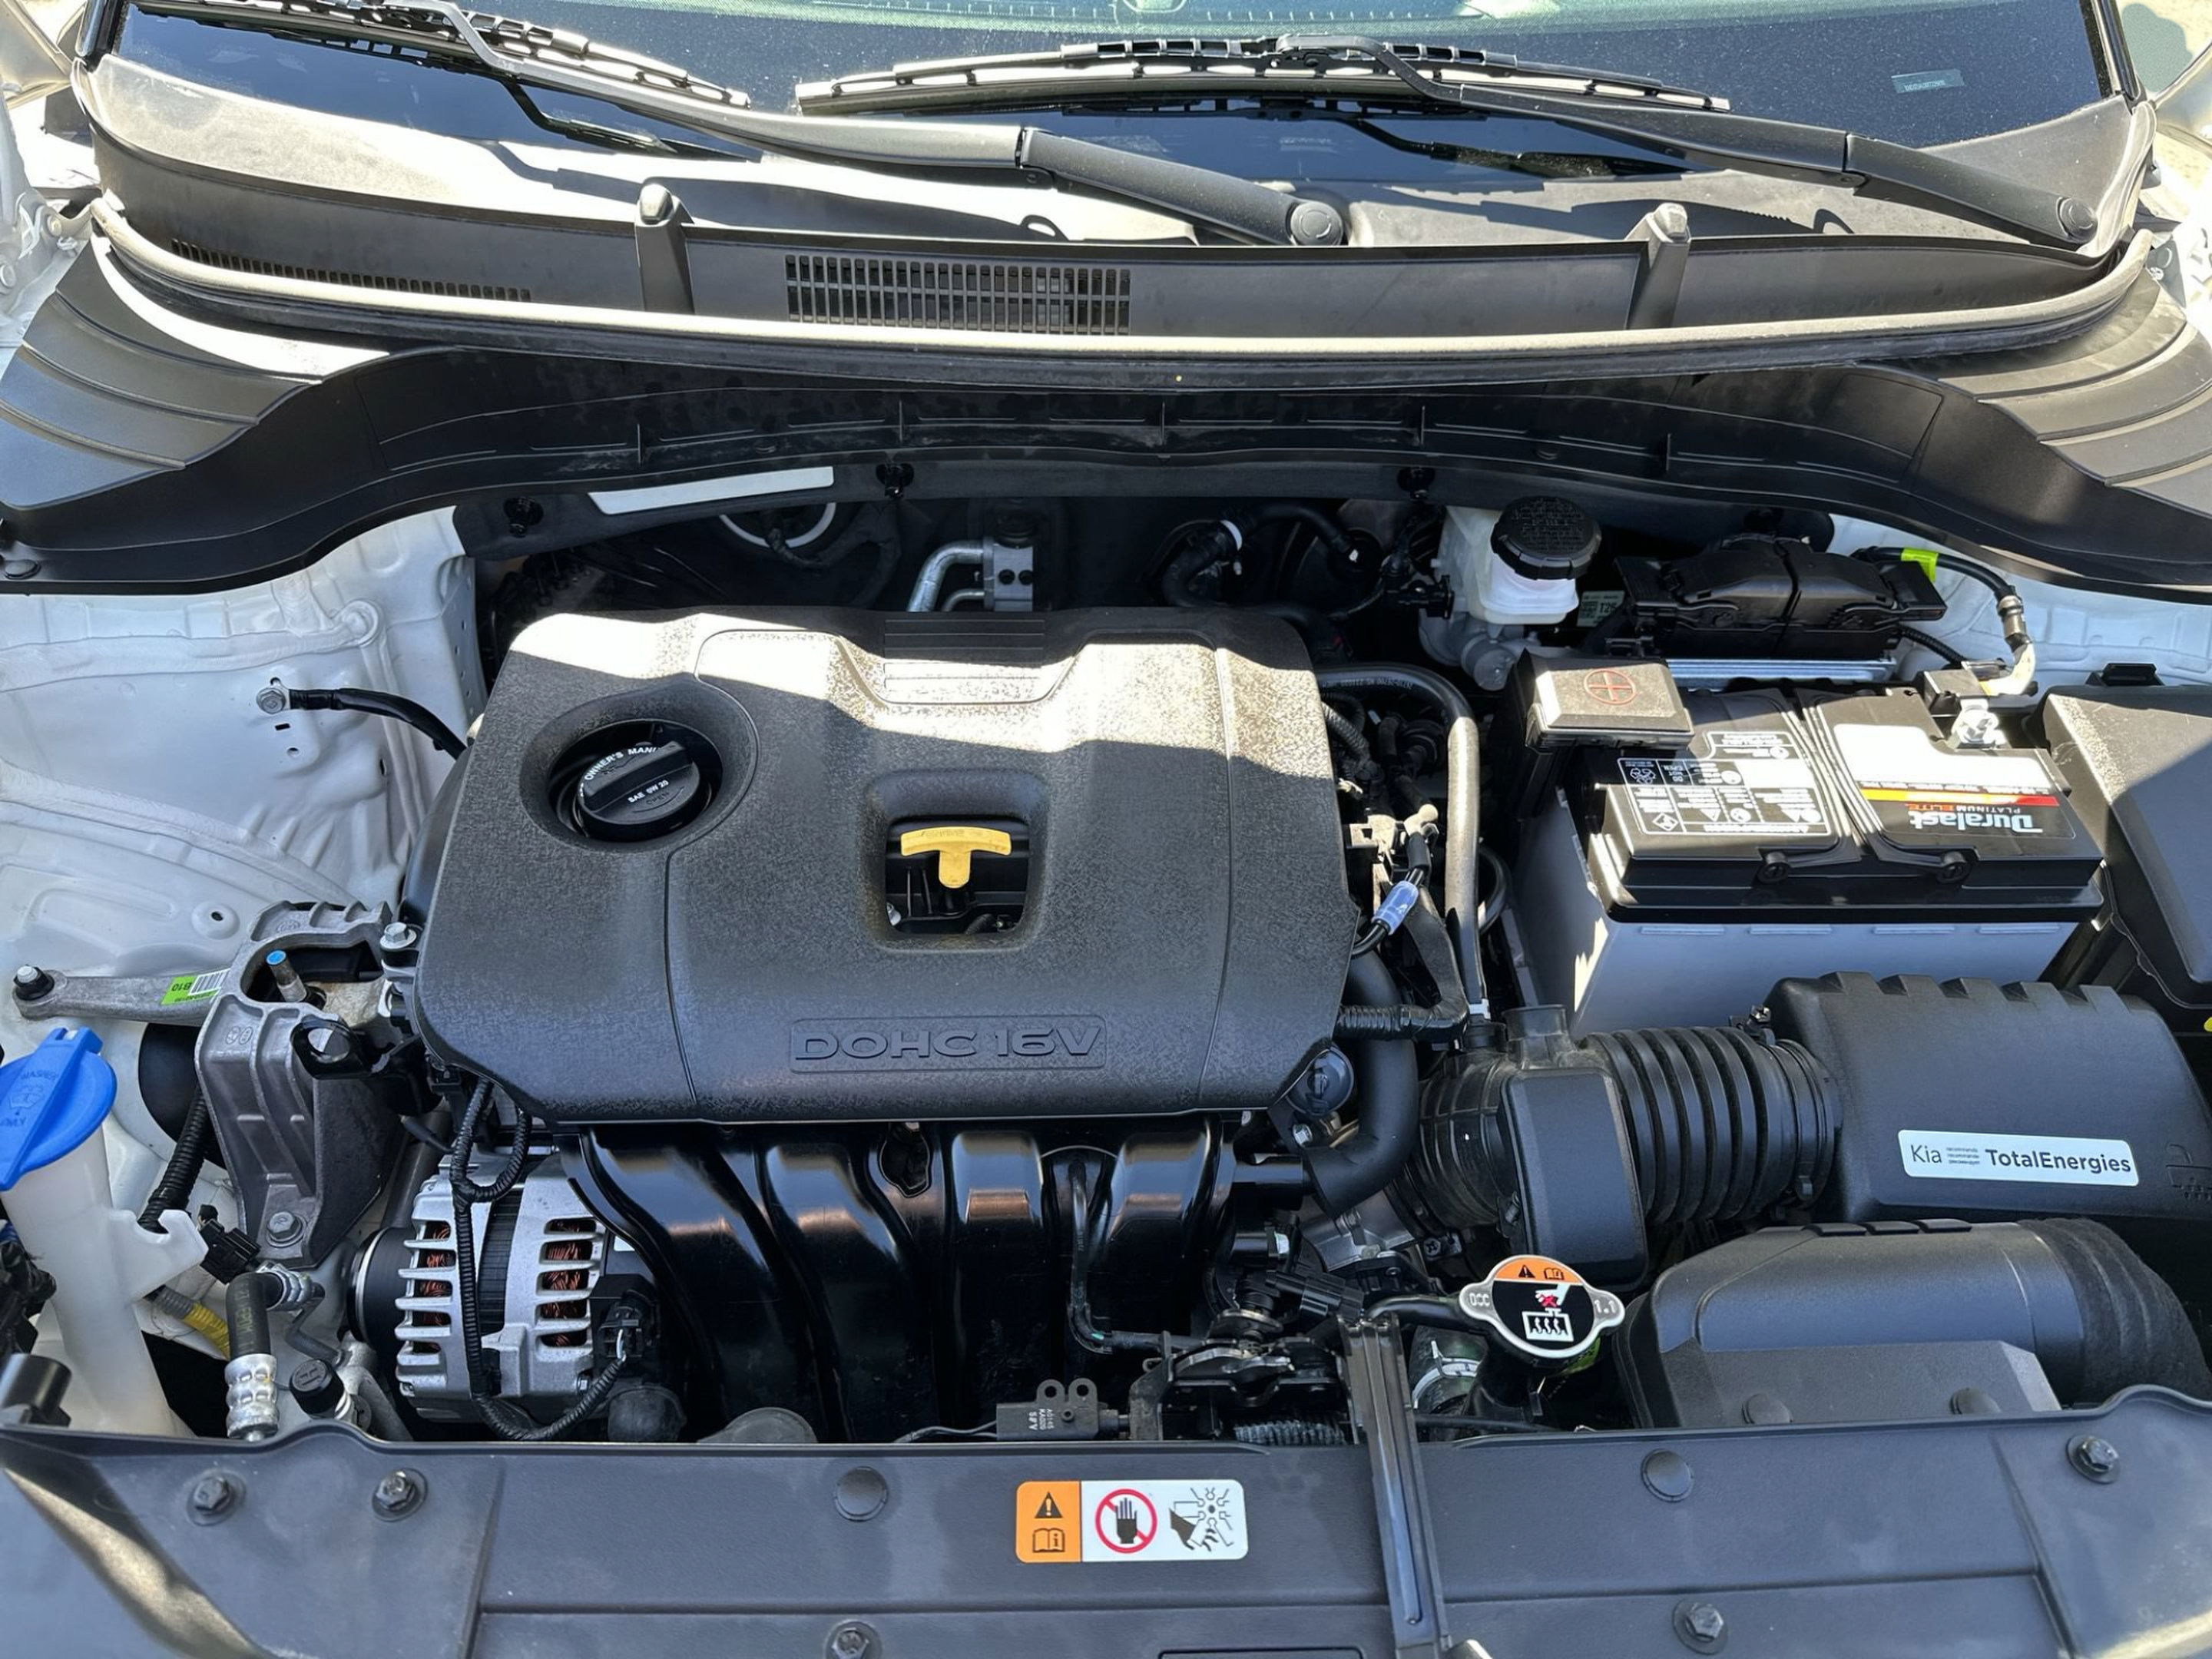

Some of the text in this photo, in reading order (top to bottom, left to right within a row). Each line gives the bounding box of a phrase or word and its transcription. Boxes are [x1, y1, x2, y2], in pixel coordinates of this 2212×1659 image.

[584, 751, 624, 780] OWNER'S
[627, 791, 646, 803] SAE
[1956, 804, 2021, 814] PLATINUM
[1909, 810, 2043, 833] Duralast
[172, 982, 192, 992] B10
[795, 1027, 1102, 1060] DOHC 16V
[1910, 1144, 1942, 1164] Kia
[1985, 1148, 2131, 1174] TotalEnergies
[1594, 1300, 1617, 1313] 1.1
